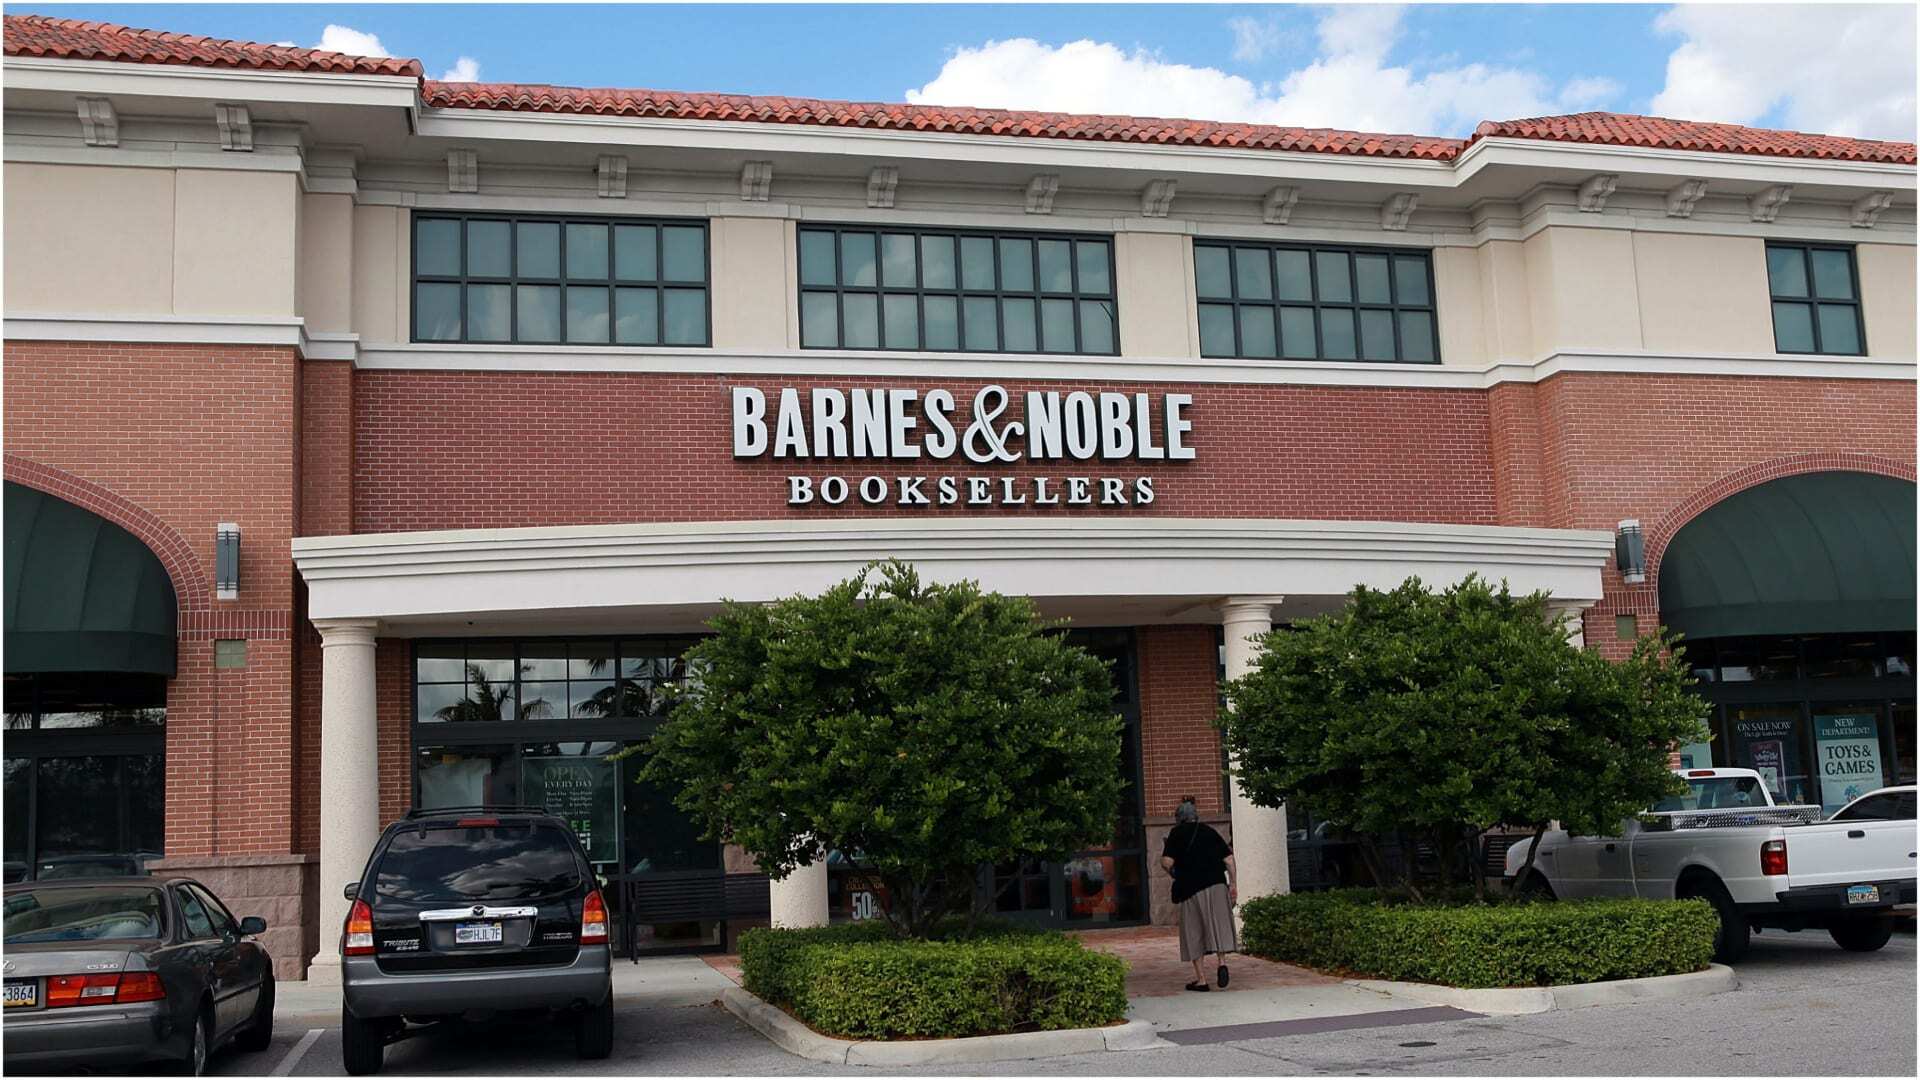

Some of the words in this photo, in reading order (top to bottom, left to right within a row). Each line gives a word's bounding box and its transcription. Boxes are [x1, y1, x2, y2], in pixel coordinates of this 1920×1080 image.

[788, 476, 1155, 504] BOOKSELLERS
[1737, 722, 1750, 731] ON
[1751, 721, 1770, 731] SALE
[1771, 720, 1792, 730] NOW
[1834, 718, 1855, 727] NEW
[1822, 727, 1870, 737] DEPARTMENT!
[544, 766, 593, 780] OPEN
[1825, 760, 1875, 776] GAMES
[545, 780, 573, 789] EVERY
[576, 780, 592, 788] DAY
